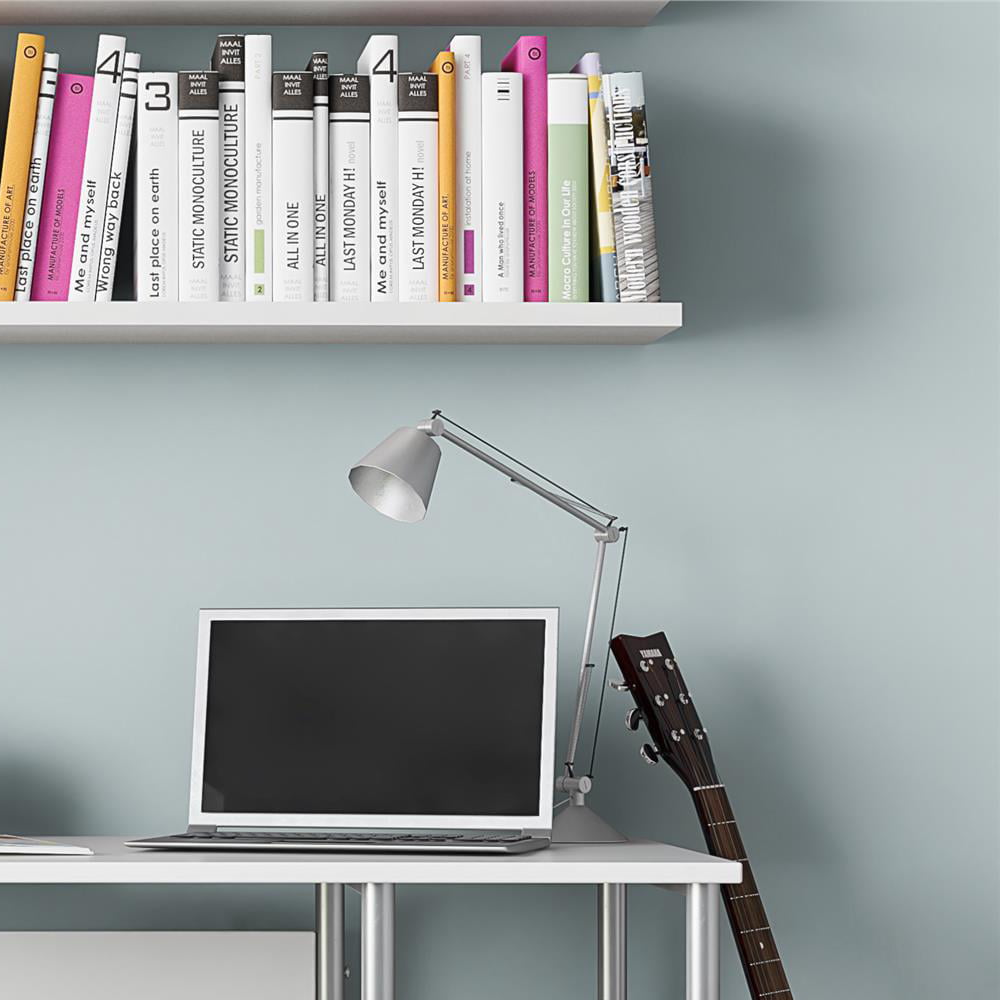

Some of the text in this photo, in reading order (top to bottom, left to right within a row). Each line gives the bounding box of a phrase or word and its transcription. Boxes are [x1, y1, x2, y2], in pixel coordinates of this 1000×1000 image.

[219, 40, 242, 48] MAAL
[220, 57, 241, 65] ALLES
[97, 50, 121, 84] 4
[373, 49, 397, 83] 4
[144, 81, 171, 111] 3
[223, 103, 239, 213] MONOCULTURE
[254, 142, 263, 195] manufacture
[346, 141, 356, 164] novel
[415, 140, 425, 164] novel
[463, 151, 472, 174] home
[191, 129, 205, 225] MONOCULTURE
[343, 167, 356, 182] H!
[411, 167, 425, 181] H!
[3, 200, 12, 214] OF
[83, 179, 97, 229] myself
[287, 201, 299, 229] ONE
[343, 183, 356, 238] MONDAY
[411, 183, 425, 238] MONDAY
[614, 190, 642, 245] wooden
[15, 157, 42, 293] Last place on earth
[47, 188, 65, 281] MANUFACTURE MODELS
[95, 171, 122, 293] Wrong way back
[148, 168, 161, 298] Last place on earth
[223, 217, 239, 264] STATIC
[287, 231, 299, 245] IN
[315, 193, 326, 267] ALL IN ONE
[376, 180, 389, 294] Me and myself
[528, 170, 536, 278] MANUFACTURE OF MODELS
[77, 233, 90, 264] and
[191, 228, 205, 270] STATIC
[287, 248, 299, 270] ALL
[343, 241, 356, 271] LAST
[411, 240, 425, 270] LAST
[441, 211, 449, 280] MANUFACTURE OF
[561, 230, 571, 266] Culture
[74, 268, 86, 293] Me
[256, 285, 263, 294] 2
[561, 268, 571, 300] Macro
